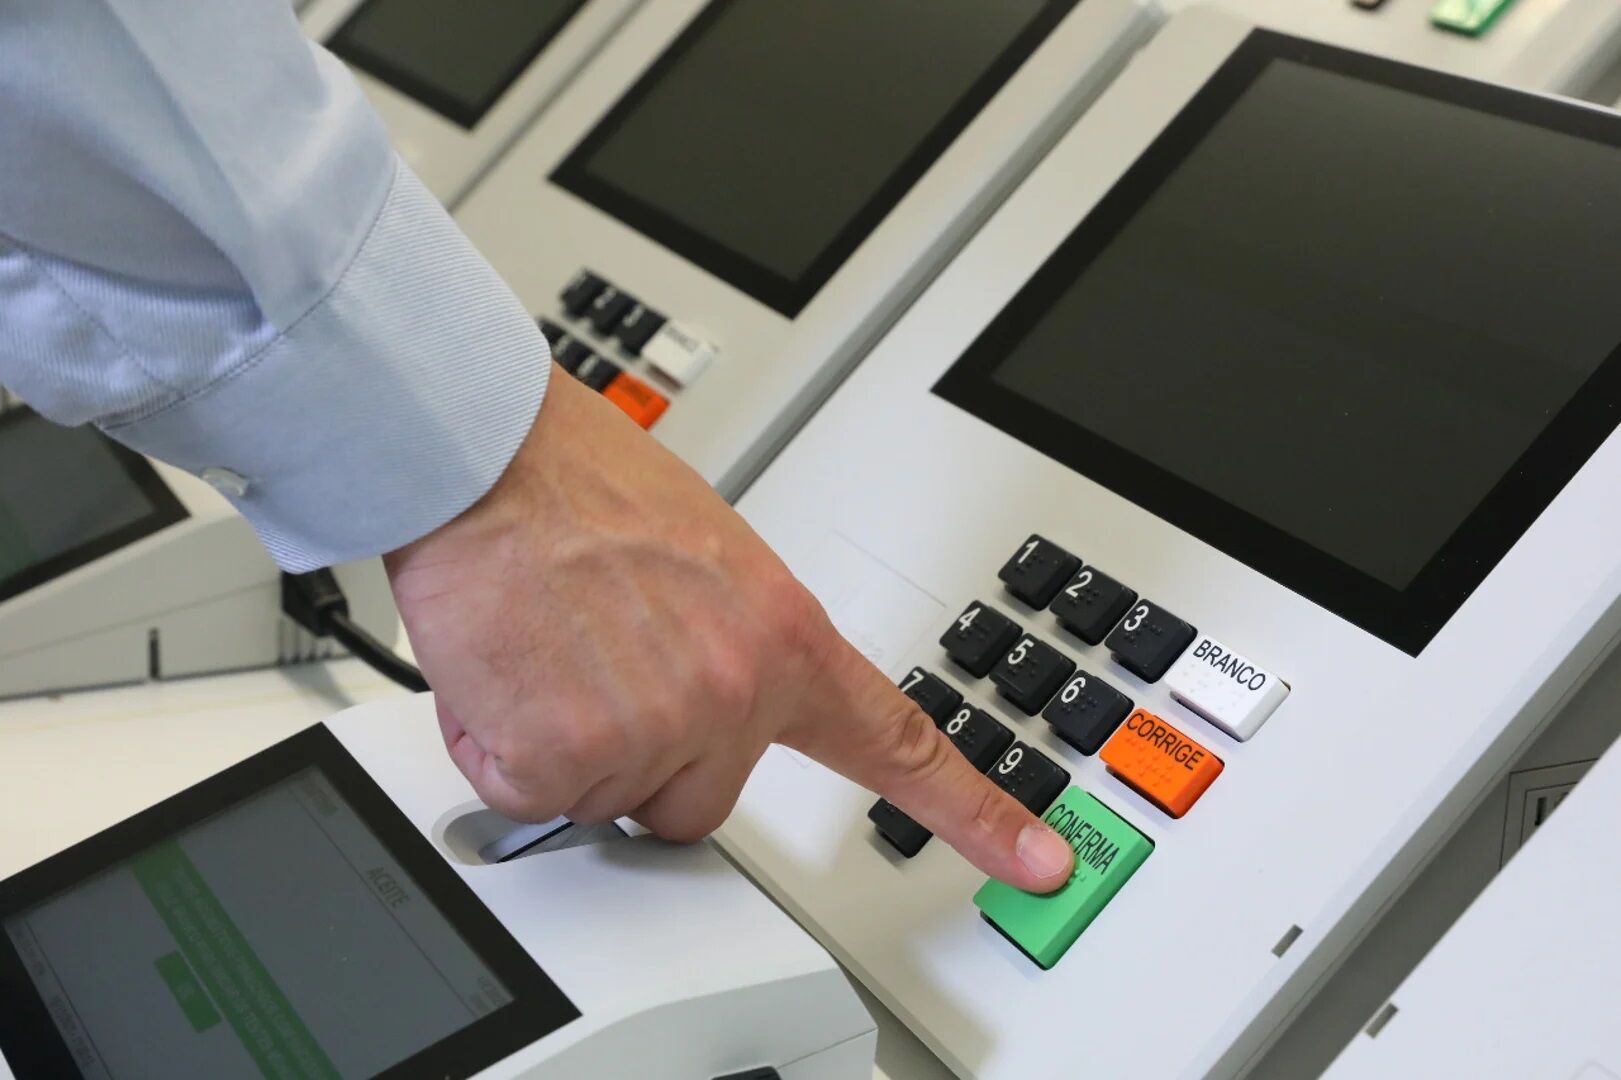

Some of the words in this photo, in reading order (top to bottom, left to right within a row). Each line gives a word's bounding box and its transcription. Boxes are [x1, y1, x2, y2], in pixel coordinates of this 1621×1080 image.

[1018, 541, 1040, 564] 1
[1065, 571, 1092, 597] 2
[958, 607, 981, 631] 4
[1124, 605, 1149, 631] 3
[1007, 639, 1035, 665] 5
[1193, 639, 1266, 691] BRANCO
[901, 671, 924, 692] 7
[1061, 677, 1086, 703] 6
[946, 709, 971, 735] 8
[1126, 713, 1204, 771] CORRIGE
[999, 748, 1023, 774] 9
[1045, 803, 1120, 875] CONFIRMA
[366, 866, 409, 908] ACEITE
